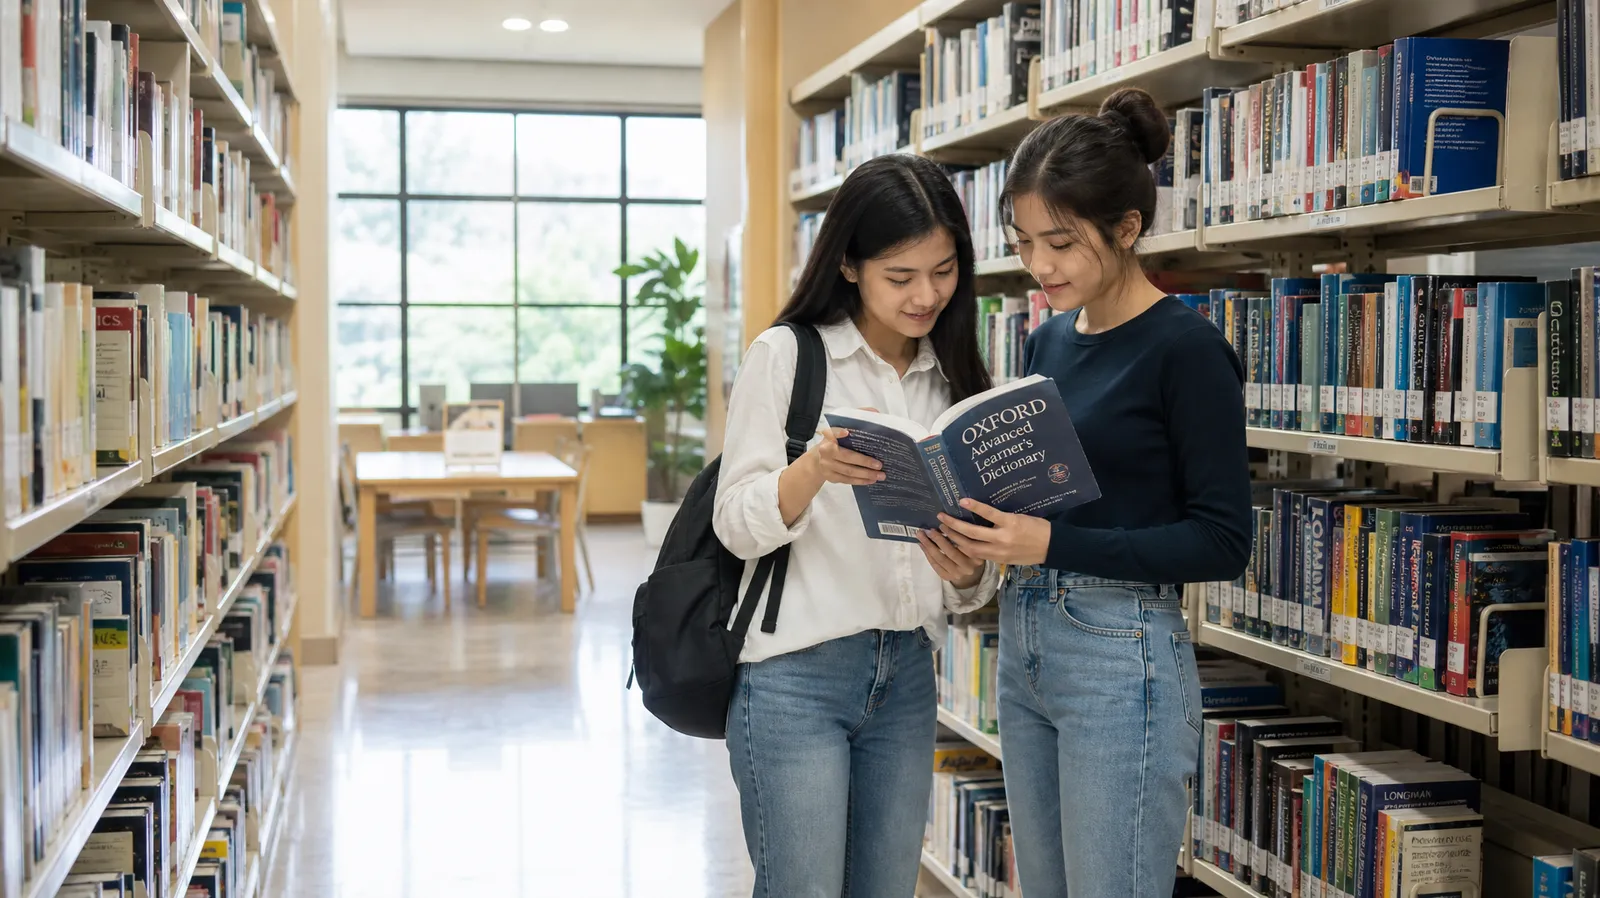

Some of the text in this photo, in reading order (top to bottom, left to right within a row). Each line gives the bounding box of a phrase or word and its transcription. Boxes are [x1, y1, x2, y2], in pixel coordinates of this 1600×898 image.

[962, 399, 1046, 445] OXFORD
[971, 420, 1034, 460] Advanced
[974, 438, 1034, 473] Learner's
[980, 449, 1045, 486] Dictionary
[1384, 789, 1432, 801] LONGMAN
